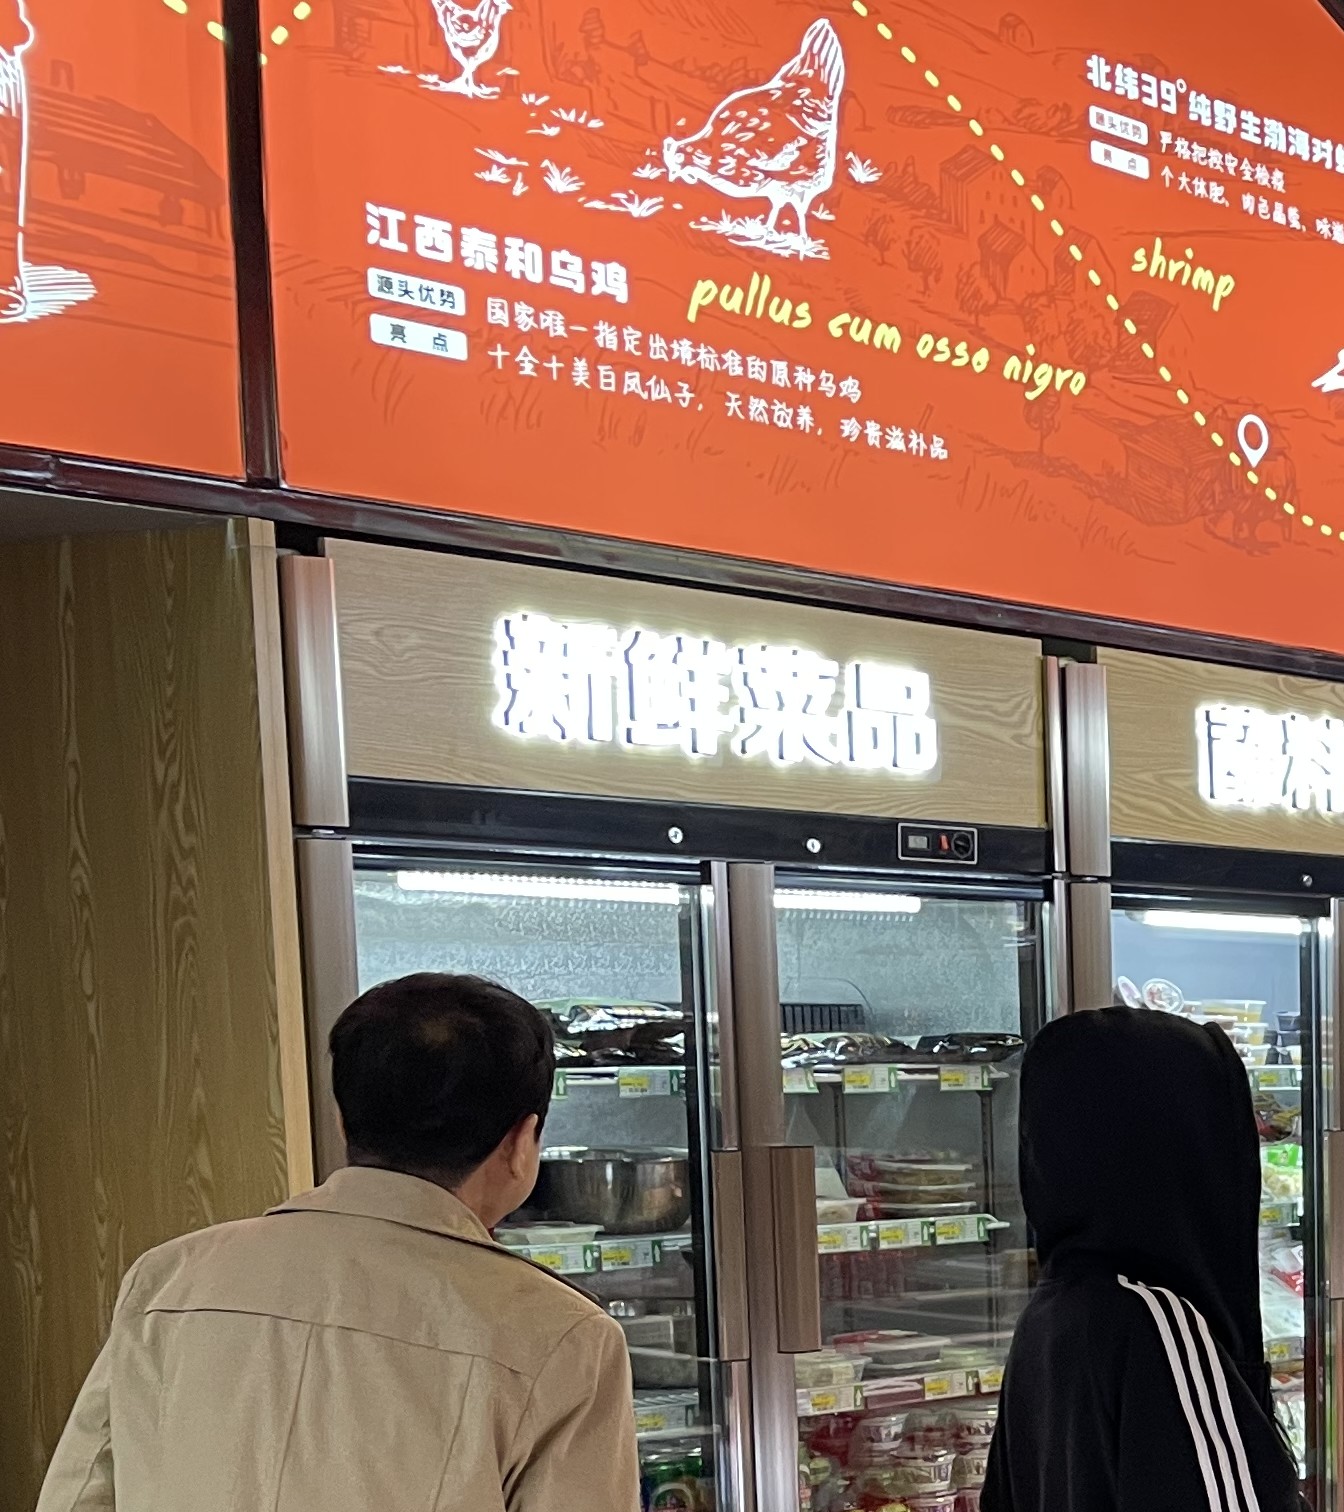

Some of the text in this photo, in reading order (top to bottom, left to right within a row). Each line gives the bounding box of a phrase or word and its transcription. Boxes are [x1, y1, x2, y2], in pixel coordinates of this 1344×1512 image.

[365, 202, 628, 303] 江西泰和乌鸡
[377, 274, 455, 308] 源头优势
[1131, 237, 1235, 311] shrimp
[487, 297, 861, 403] 国家唯一指定出境标准的原种乌鸡
[687, 272, 812, 329] pullus
[828, 313, 901, 353] cum
[1002, 344, 1086, 400] nigro
[494, 612, 938, 771] 新鲜菜品
